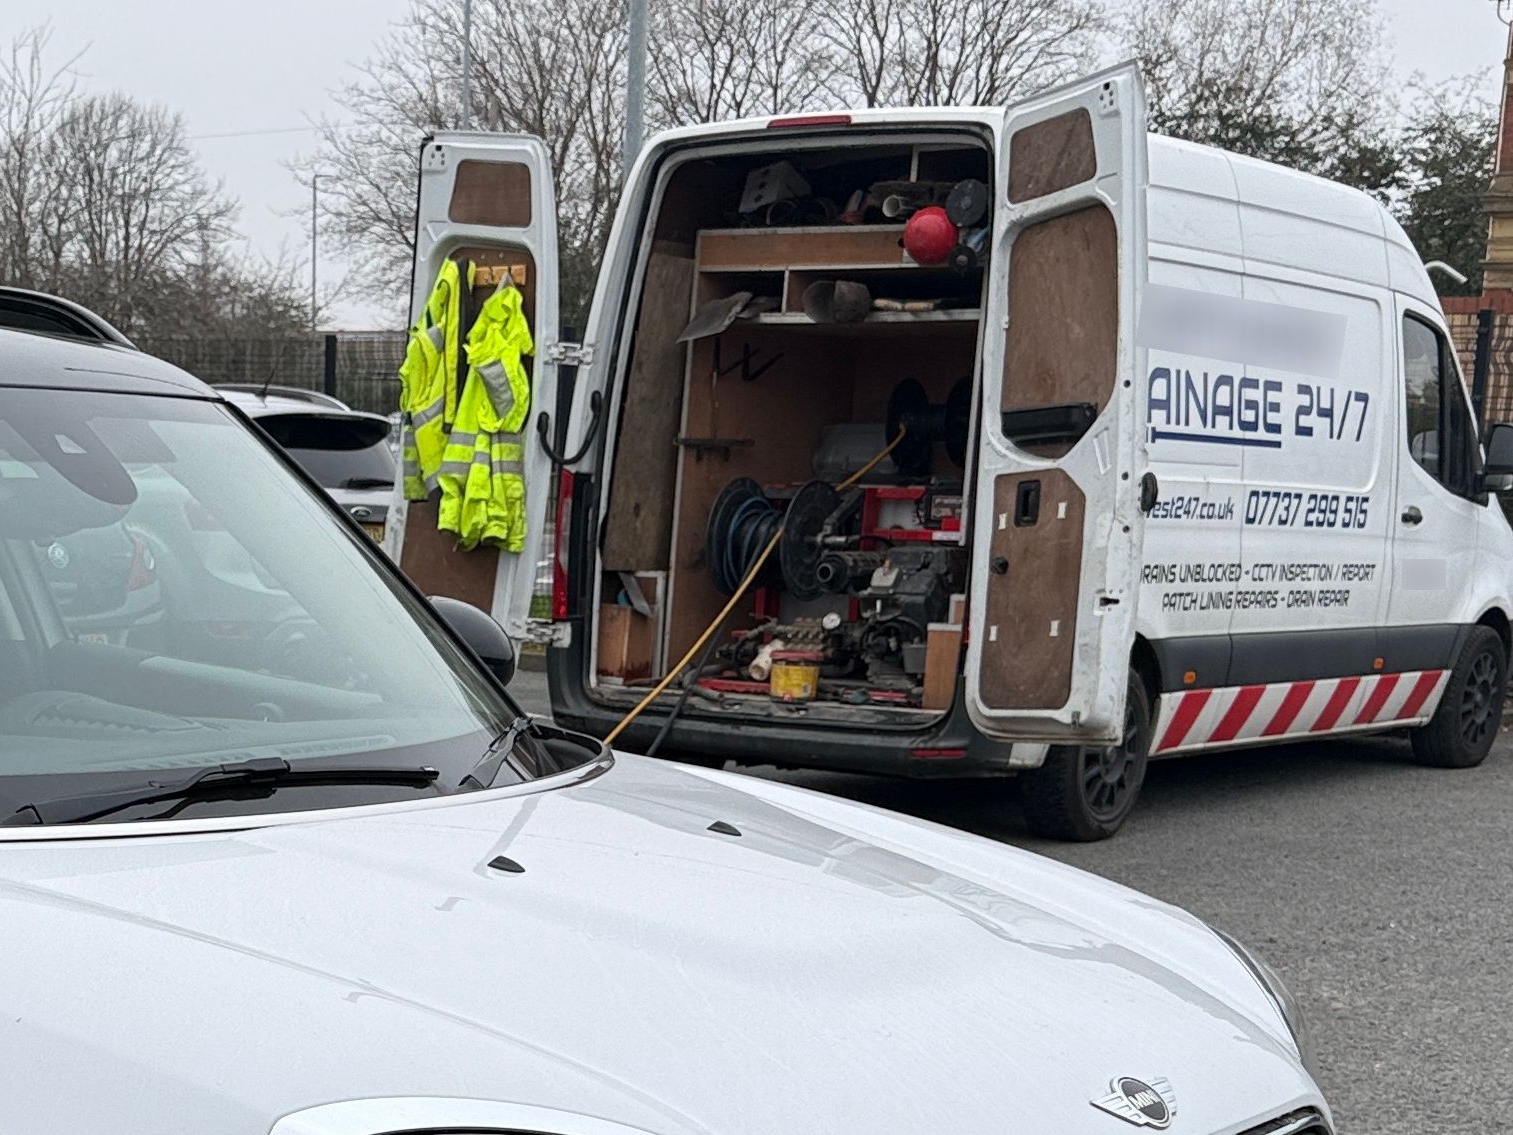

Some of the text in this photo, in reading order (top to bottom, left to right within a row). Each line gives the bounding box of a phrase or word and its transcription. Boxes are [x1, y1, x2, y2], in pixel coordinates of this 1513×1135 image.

[1147, 366, 1370, 442] AINAGE 24/7
[1245, 490, 1303, 527] 07737
[1304, 494, 1340, 528] 299
[1342, 496, 1370, 529] 515
[1179, 563, 1242, 583] UNBLOCKED
[1251, 563, 1279, 582] CCTV
[1278, 563, 1334, 582] INSPECTION
[1341, 563, 1376, 582] REPORT
[1162, 591, 1199, 612] PATCH
[1199, 590, 1234, 611] LINING
[1233, 590, 1279, 609] REPAIRS
[1286, 589, 1317, 608] DRAIN
[1316, 589, 1350, 608] REPAIR
[1127, 1089, 1163, 1109] MINI
